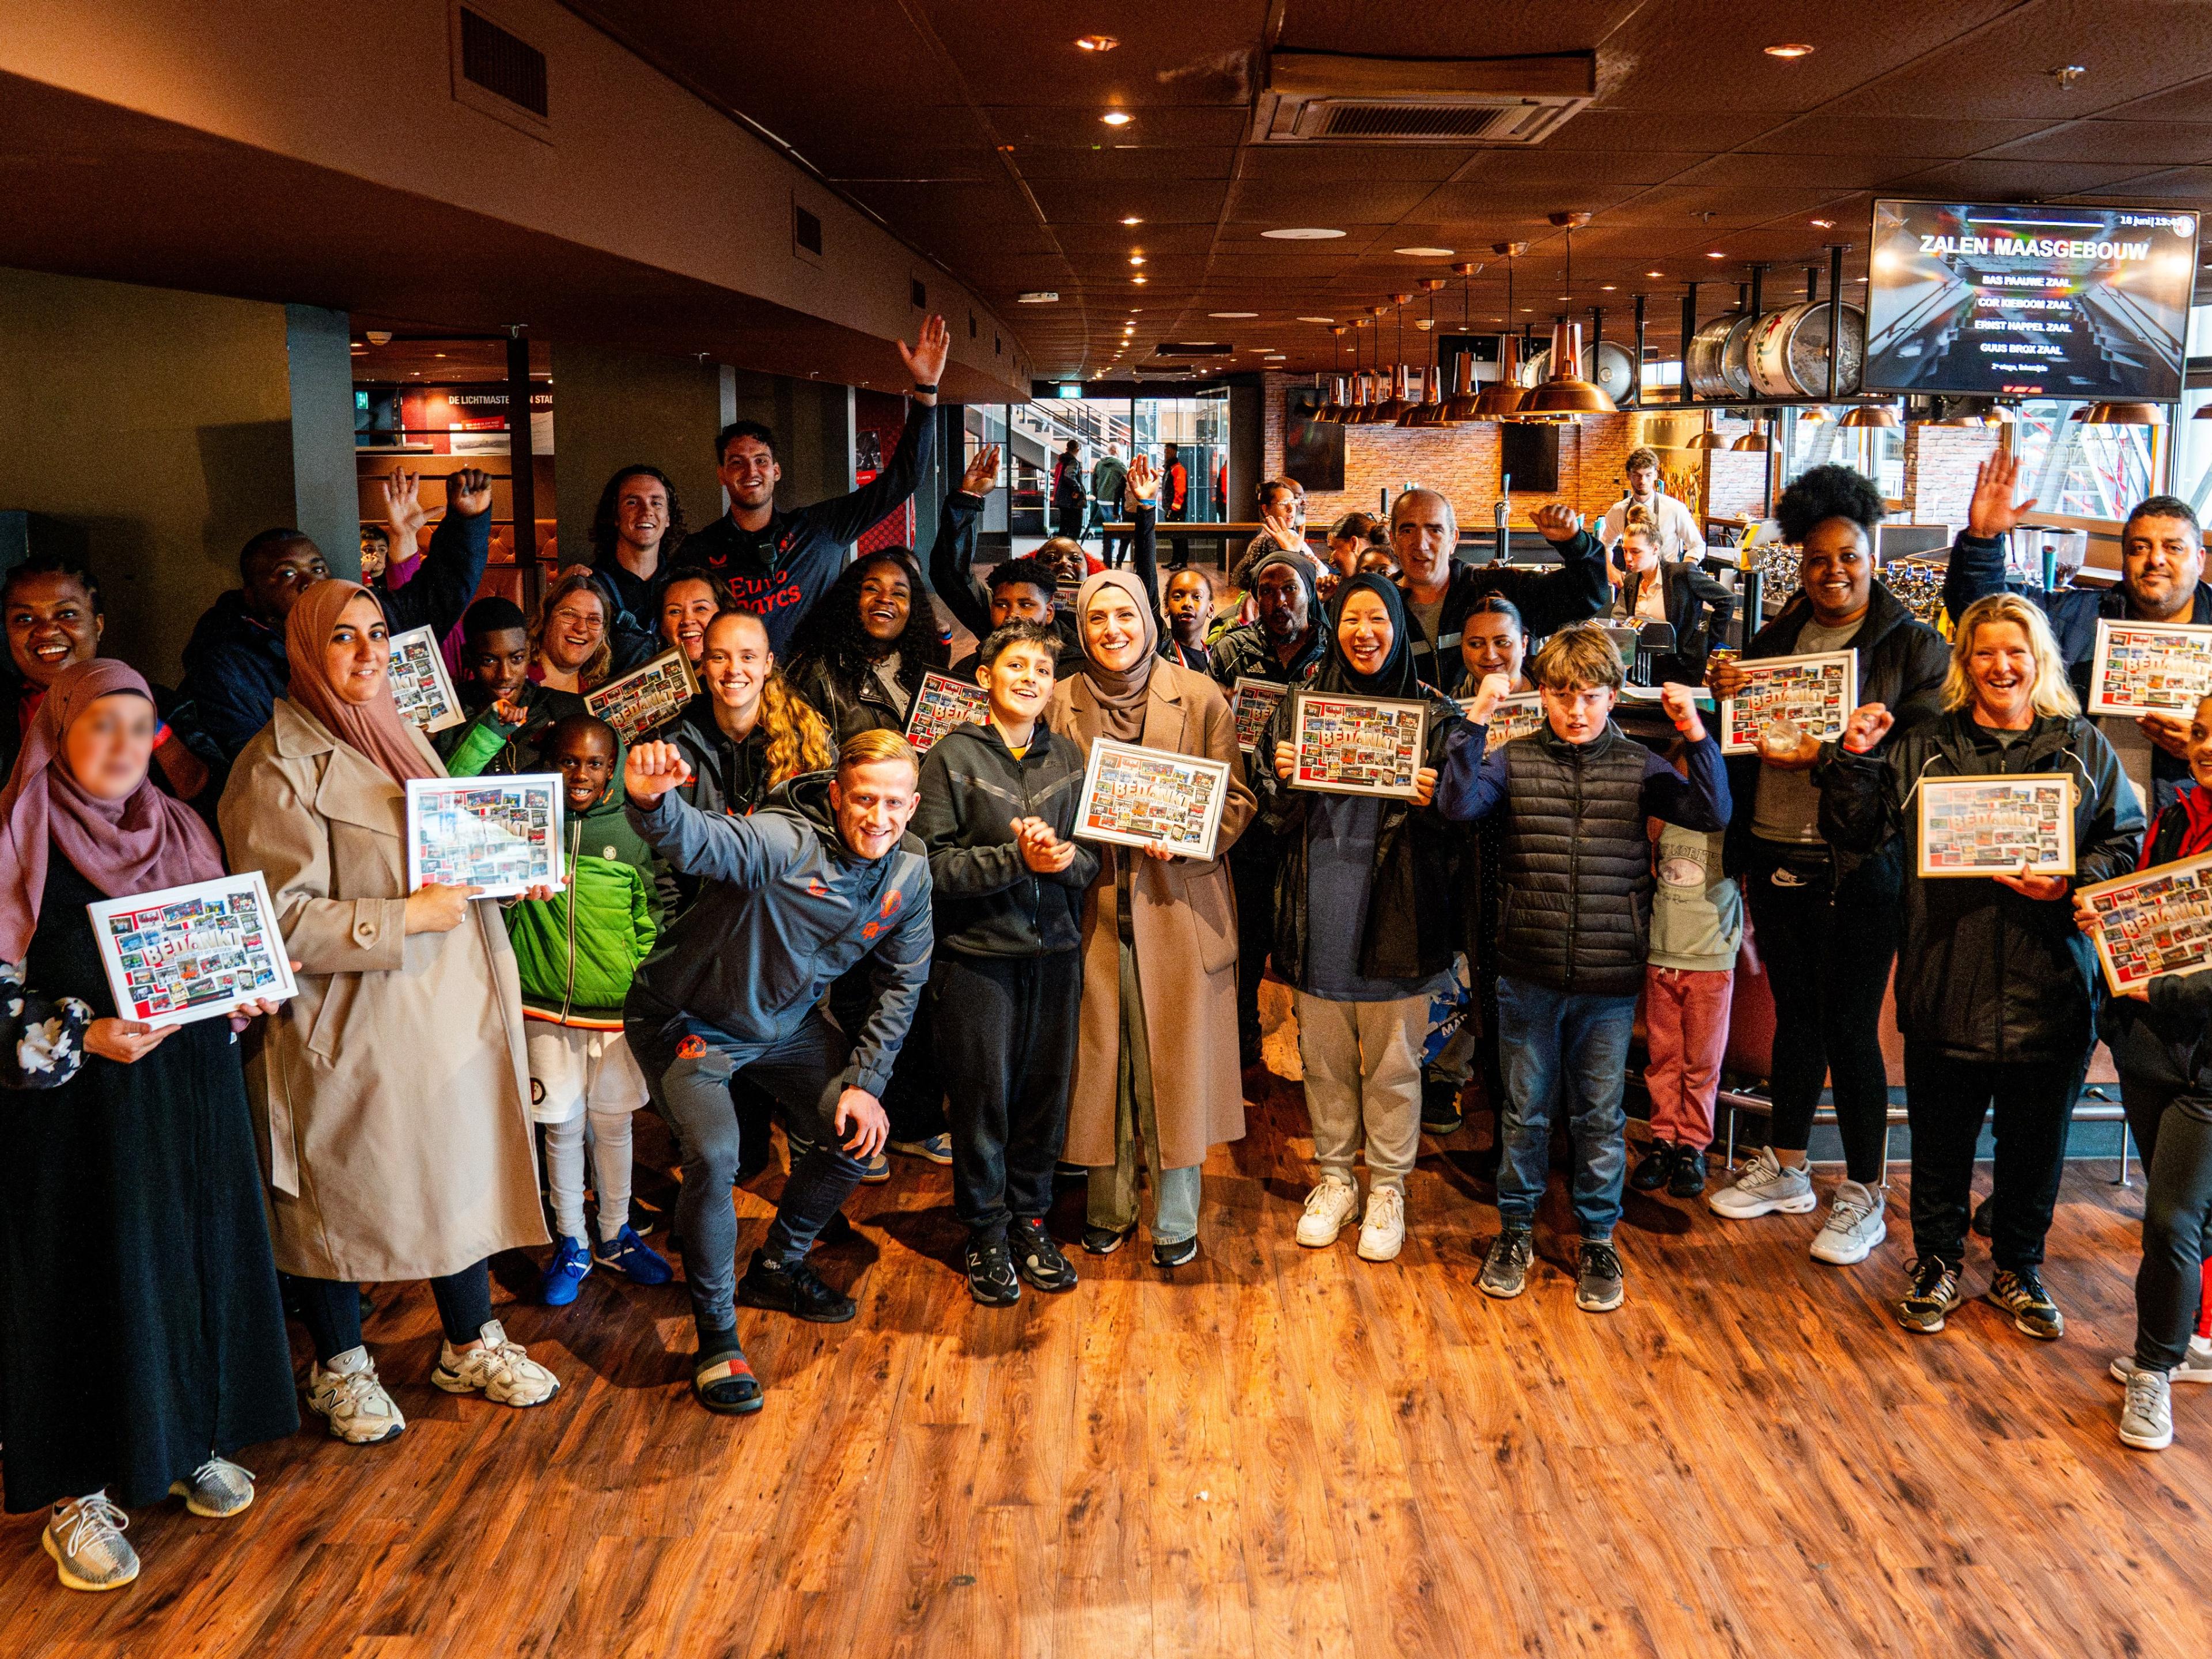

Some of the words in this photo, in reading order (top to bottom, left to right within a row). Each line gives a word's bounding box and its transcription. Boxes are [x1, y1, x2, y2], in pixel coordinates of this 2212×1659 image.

[2120, 215, 2132, 225] 18
[1919, 235, 1988, 255] ZALEN
[1994, 238, 2150, 260] MAASGEBOUW
[1982, 275, 2003, 285] BAS
[2046, 278, 2073, 287] ZAAL
[1978, 298, 2000, 307] COR
[2046, 300, 2073, 310] ZAAL
[1975, 320, 2008, 330] ERNST
[2008, 321, 2046, 332] HAPPEL
[2046, 323, 2073, 332] ZAAL
[1980, 343, 2008, 353] GUUS
[2009, 344, 2037, 354] BROX
[2036, 346, 2063, 355] ZAAL
[449, 396, 460, 404] DE
[461, 395, 510, 404] LICHTMASTE
[729, 570, 788, 598] Euro
[1321, 730, 1397, 751] BEDANKT
[1114, 781, 1188, 808] BEDANKT
[143, 927, 241, 965] BEDANKT
